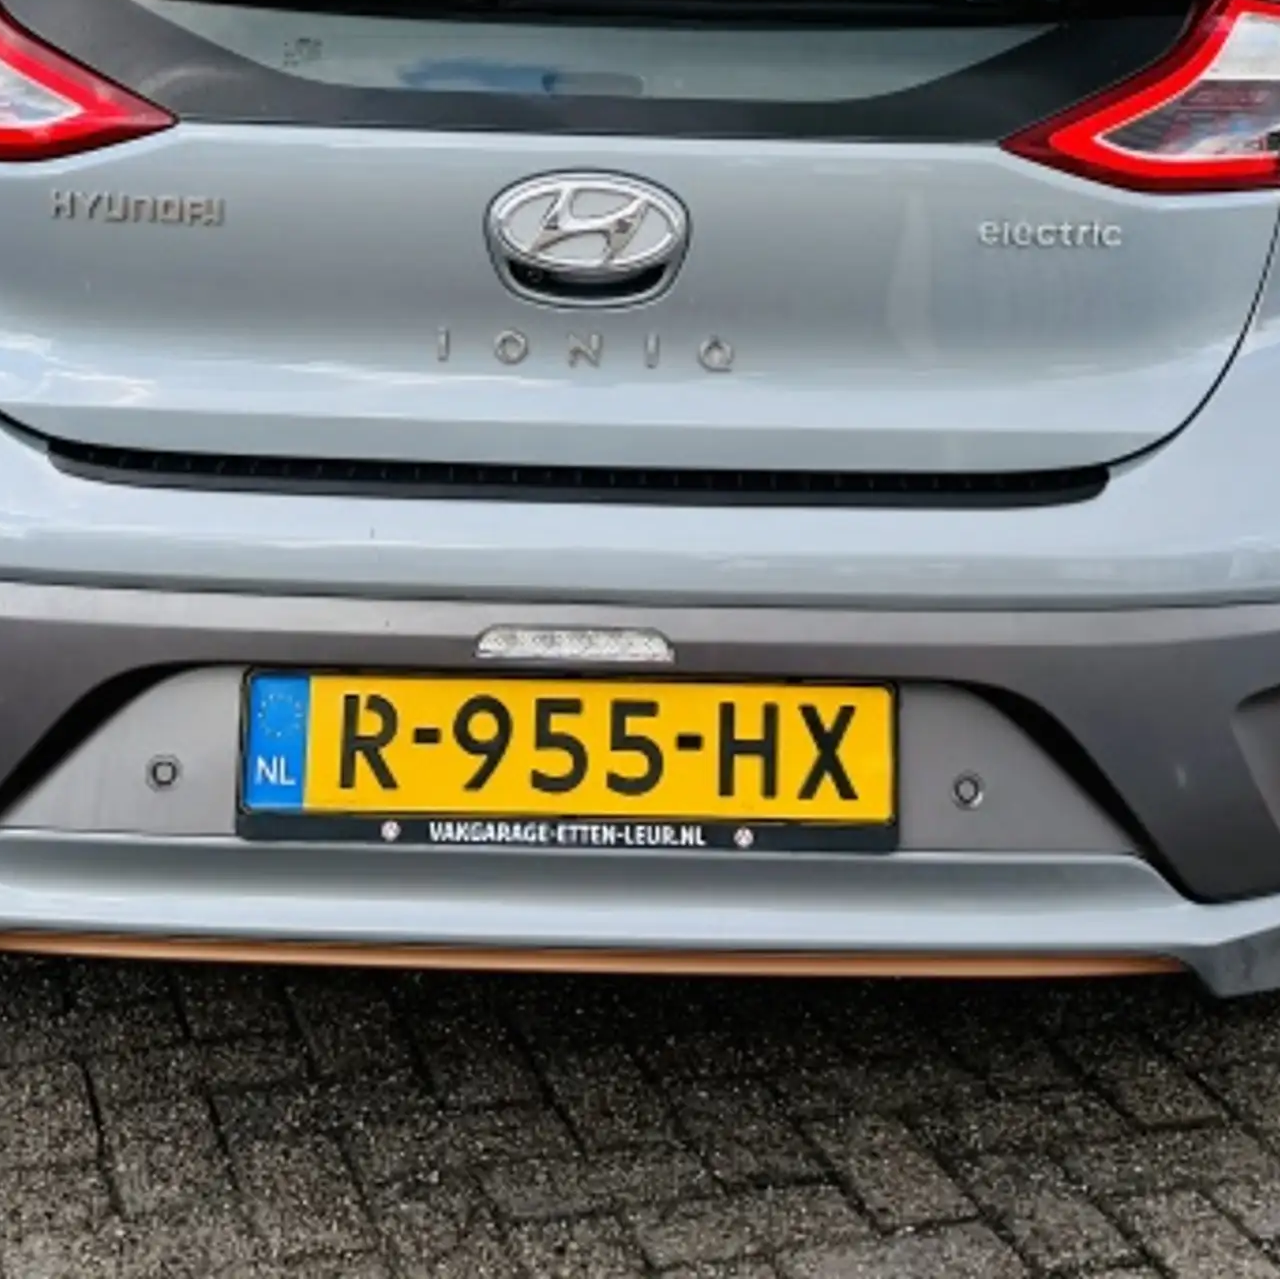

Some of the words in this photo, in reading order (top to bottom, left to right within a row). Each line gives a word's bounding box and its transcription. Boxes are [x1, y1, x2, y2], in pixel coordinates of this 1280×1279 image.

[51, 188, 226, 226] HYUNDAI
[978, 220, 1123, 246] electric
[437, 326, 736, 374] IONIQ
[337, 692, 860, 802] R-955-HX
[255, 754, 296, 787] NL
